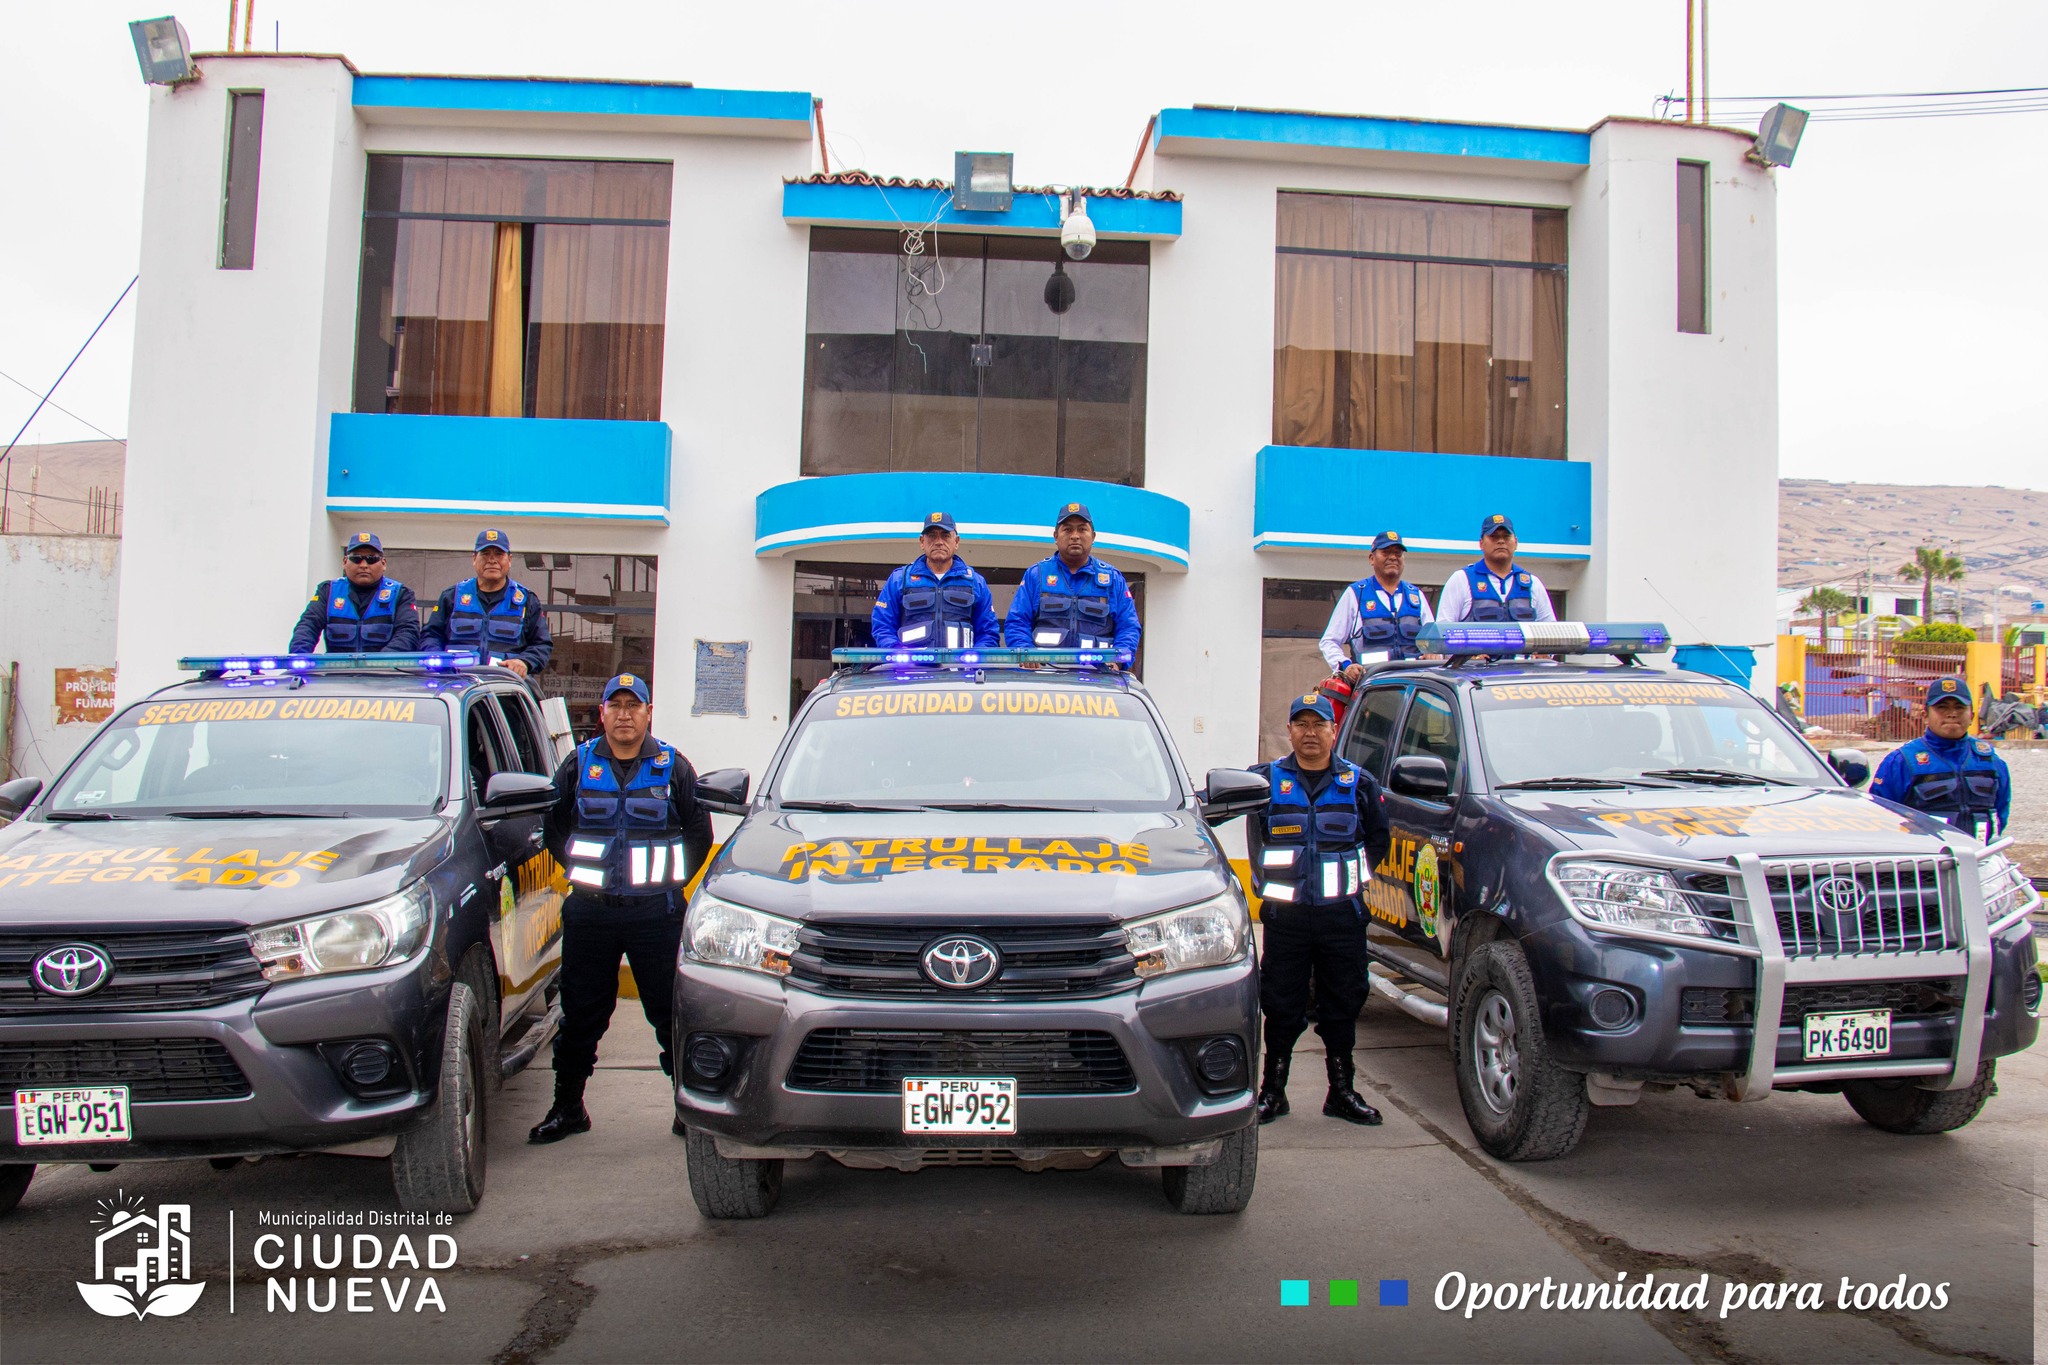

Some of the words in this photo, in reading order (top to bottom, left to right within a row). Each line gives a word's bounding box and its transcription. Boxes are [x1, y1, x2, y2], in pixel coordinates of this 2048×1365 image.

[1491, 684, 1612, 701] SEGURIDAD
[1614, 684, 1731, 700] CIUDADANA
[1547, 698, 1623, 706] CIUDAD
[138, 699, 276, 726] SEGURIDAD
[279, 699, 416, 721] CIUDADANA
[835, 693, 973, 716] SEGURIDAD
[981, 692, 1120, 717] CIUDADANA
[1656, 817, 1910, 839] INTEGRADO
[781, 837, 1152, 863] PATRULLAJE
[788, 855, 1138, 881] INTEGRADO
[1842, 1018, 1856, 1027] PE
[941, 1081, 979, 1093] PERU
[53, 1091, 92, 1103] PERU
